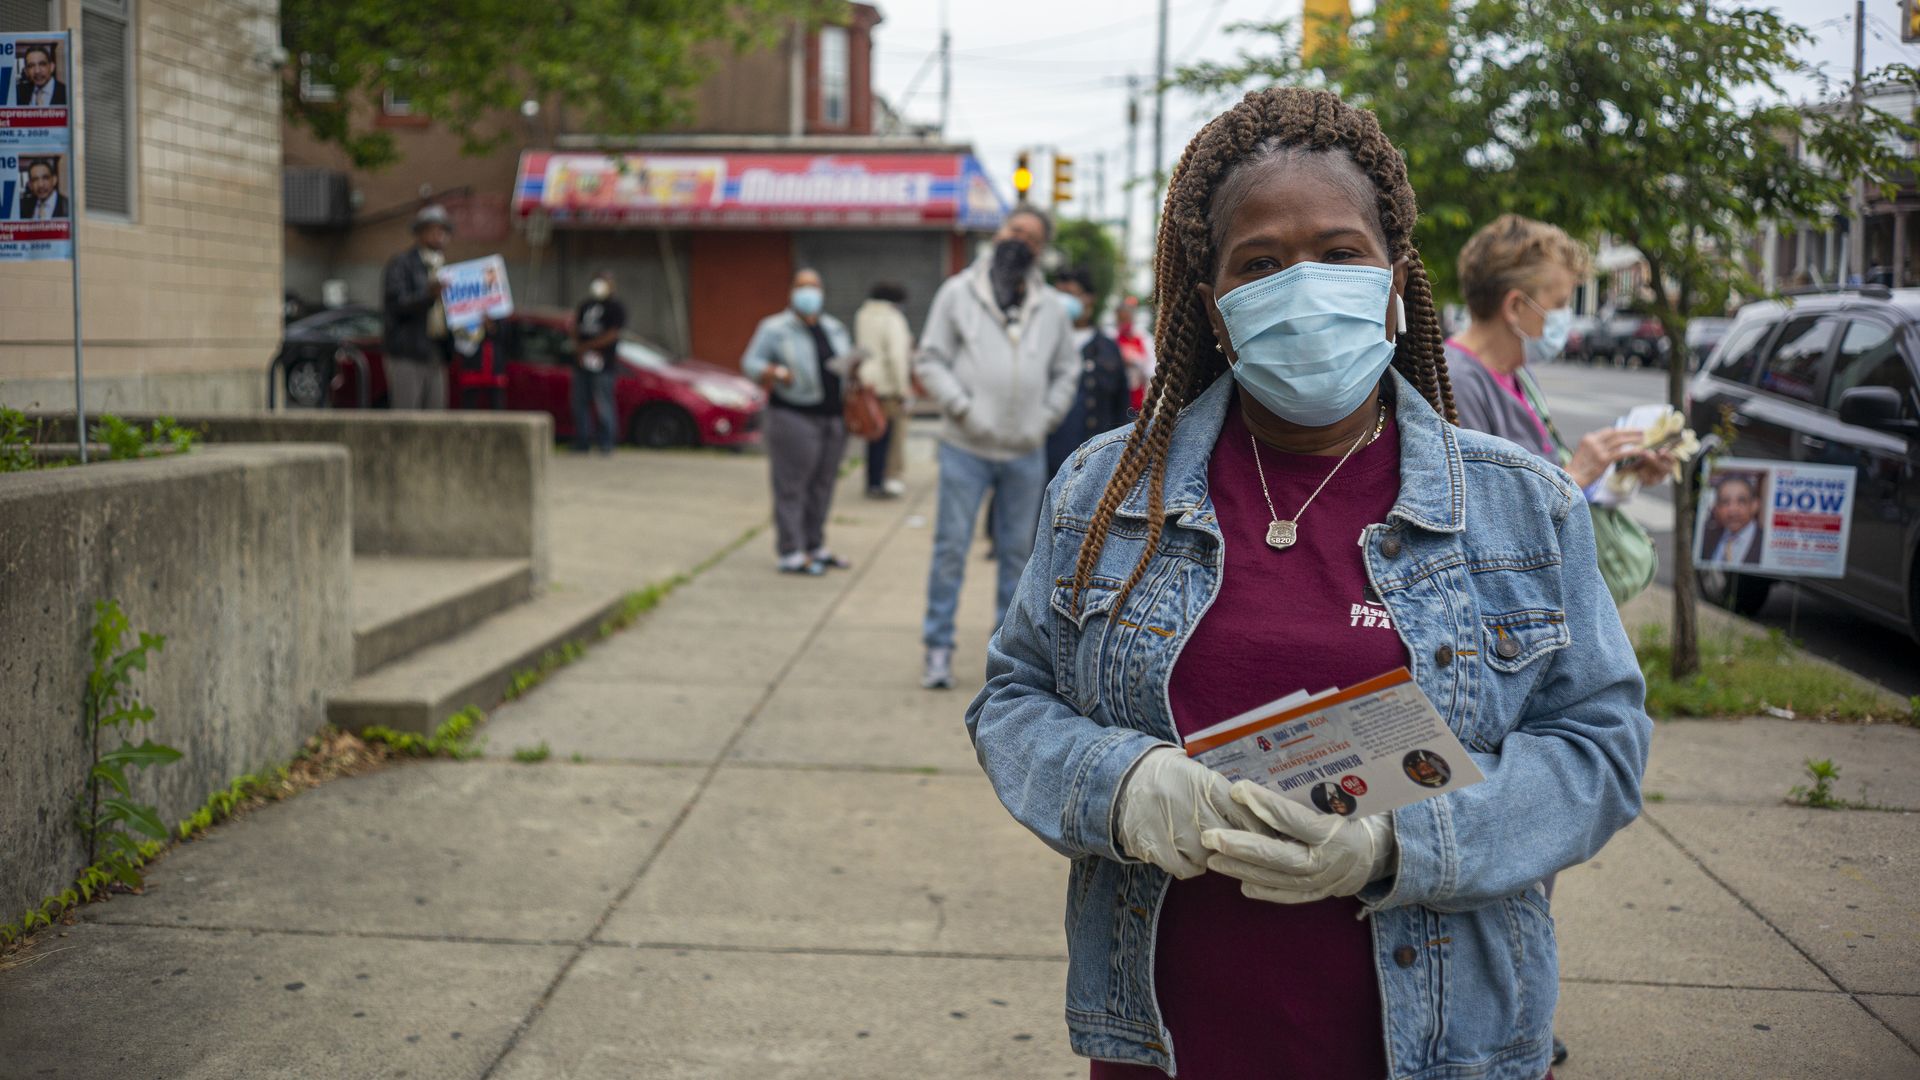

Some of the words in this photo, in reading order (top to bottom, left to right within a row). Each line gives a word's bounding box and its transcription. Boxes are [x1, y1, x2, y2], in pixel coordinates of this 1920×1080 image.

[1775, 492, 1845, 512] DOW
[1350, 615, 1397, 630] TRA
[1327, 740, 1351, 754] STATE
[1268, 750, 1328, 775] REPRESENTATIVE
[1323, 754, 1364, 776] BERNARD
[1278, 770, 1319, 792] WILLIAMS
